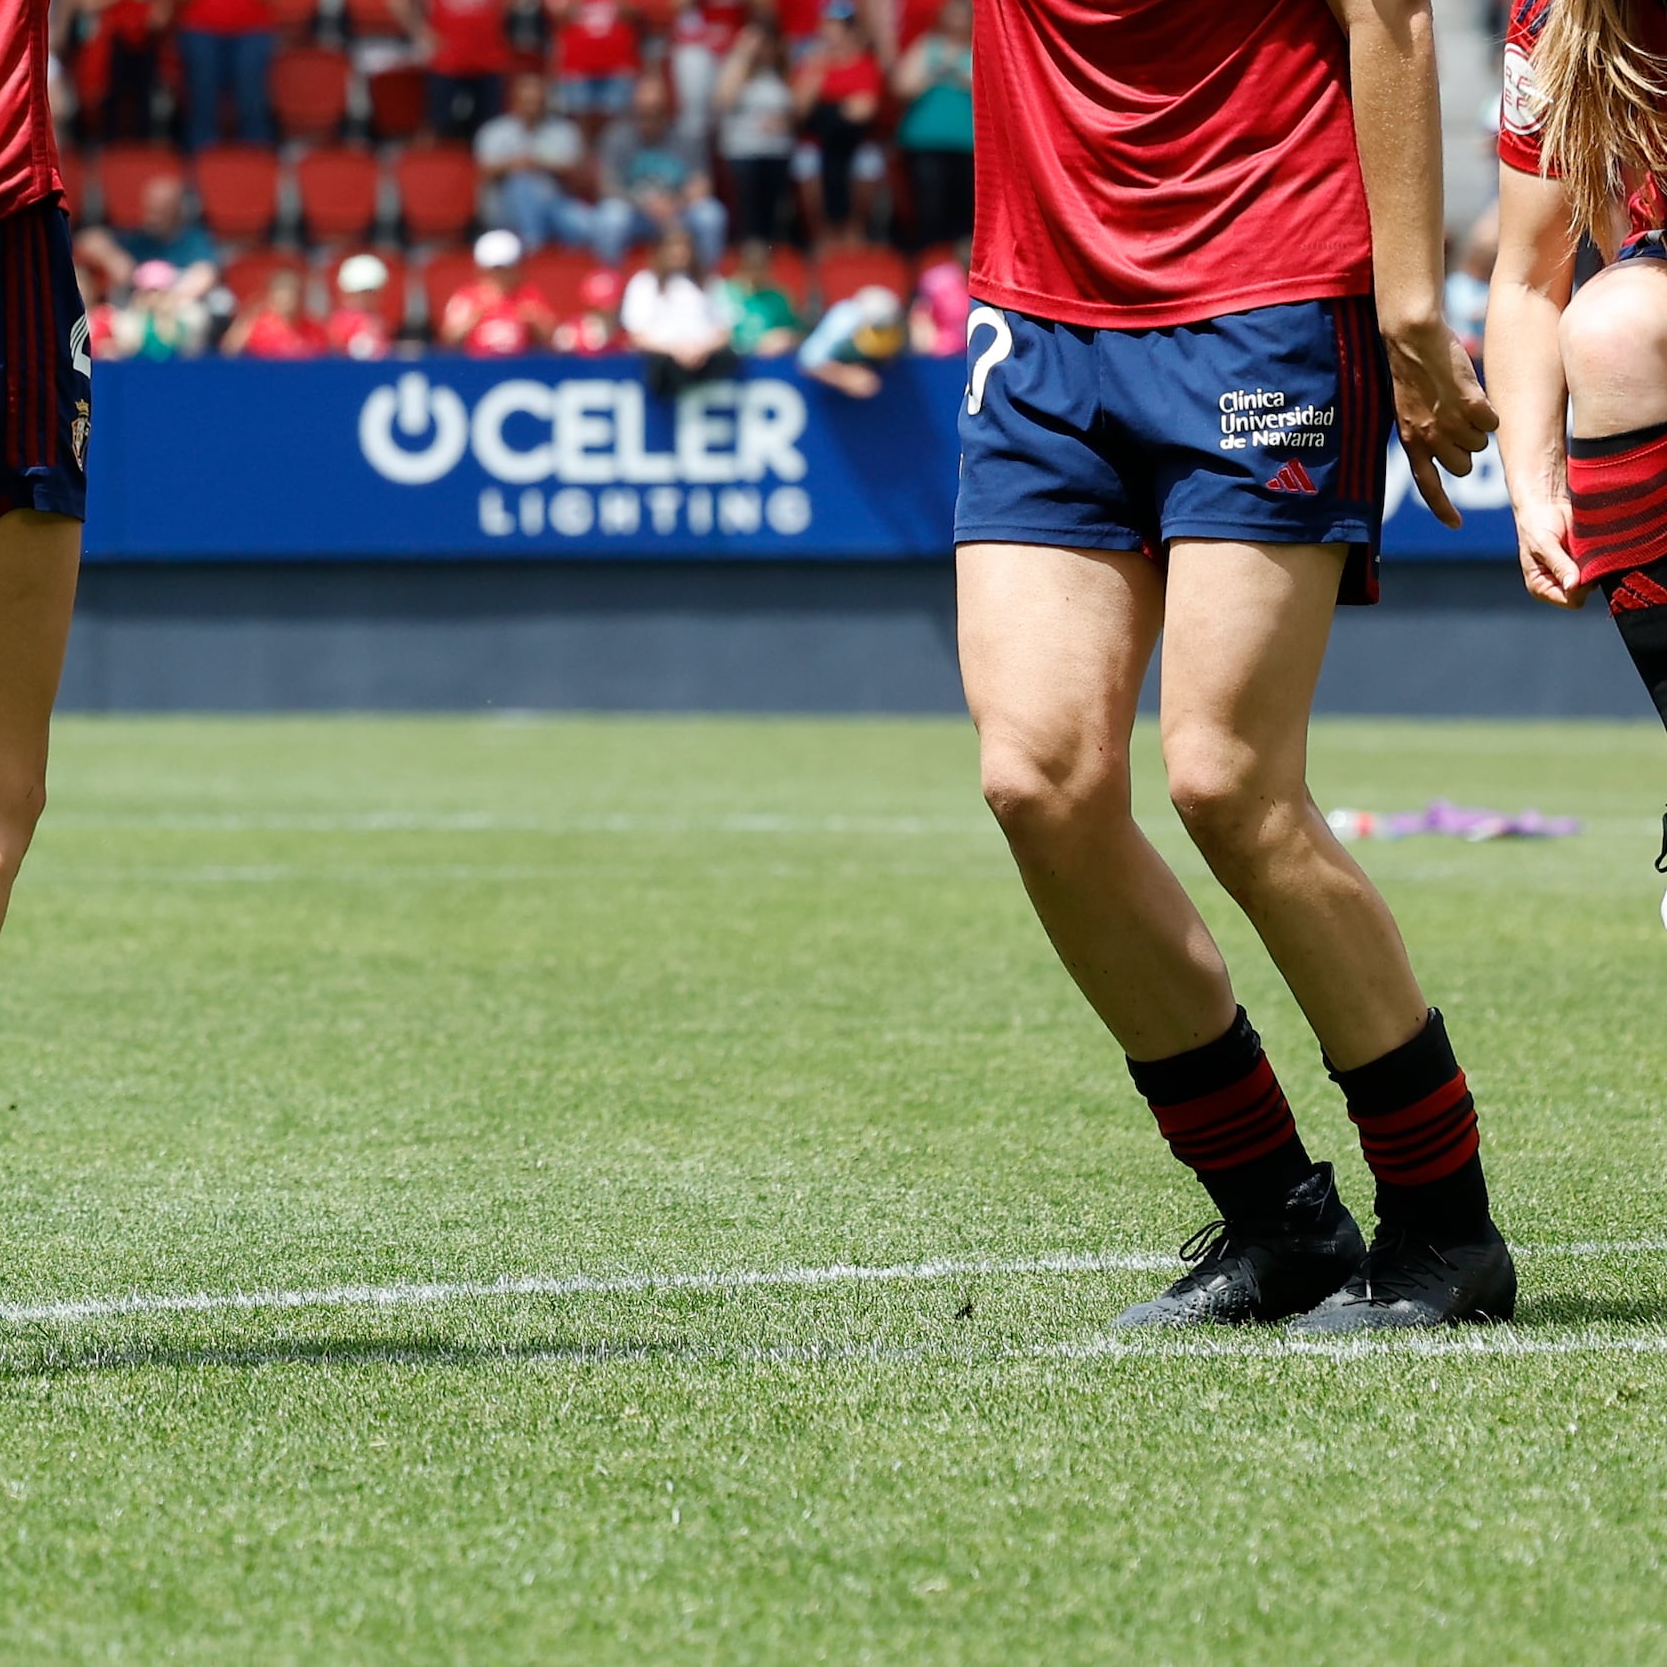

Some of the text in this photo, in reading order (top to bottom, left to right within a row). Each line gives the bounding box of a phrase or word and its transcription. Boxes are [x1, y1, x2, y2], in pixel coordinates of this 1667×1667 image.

[1219, 388, 1285, 413] Clínica
[470, 378, 809, 484] CELER
[1220, 405, 1334, 434] Universidad
[1219, 430, 1325, 450] de Navarra
[477, 485, 813, 537] LIGHTING
